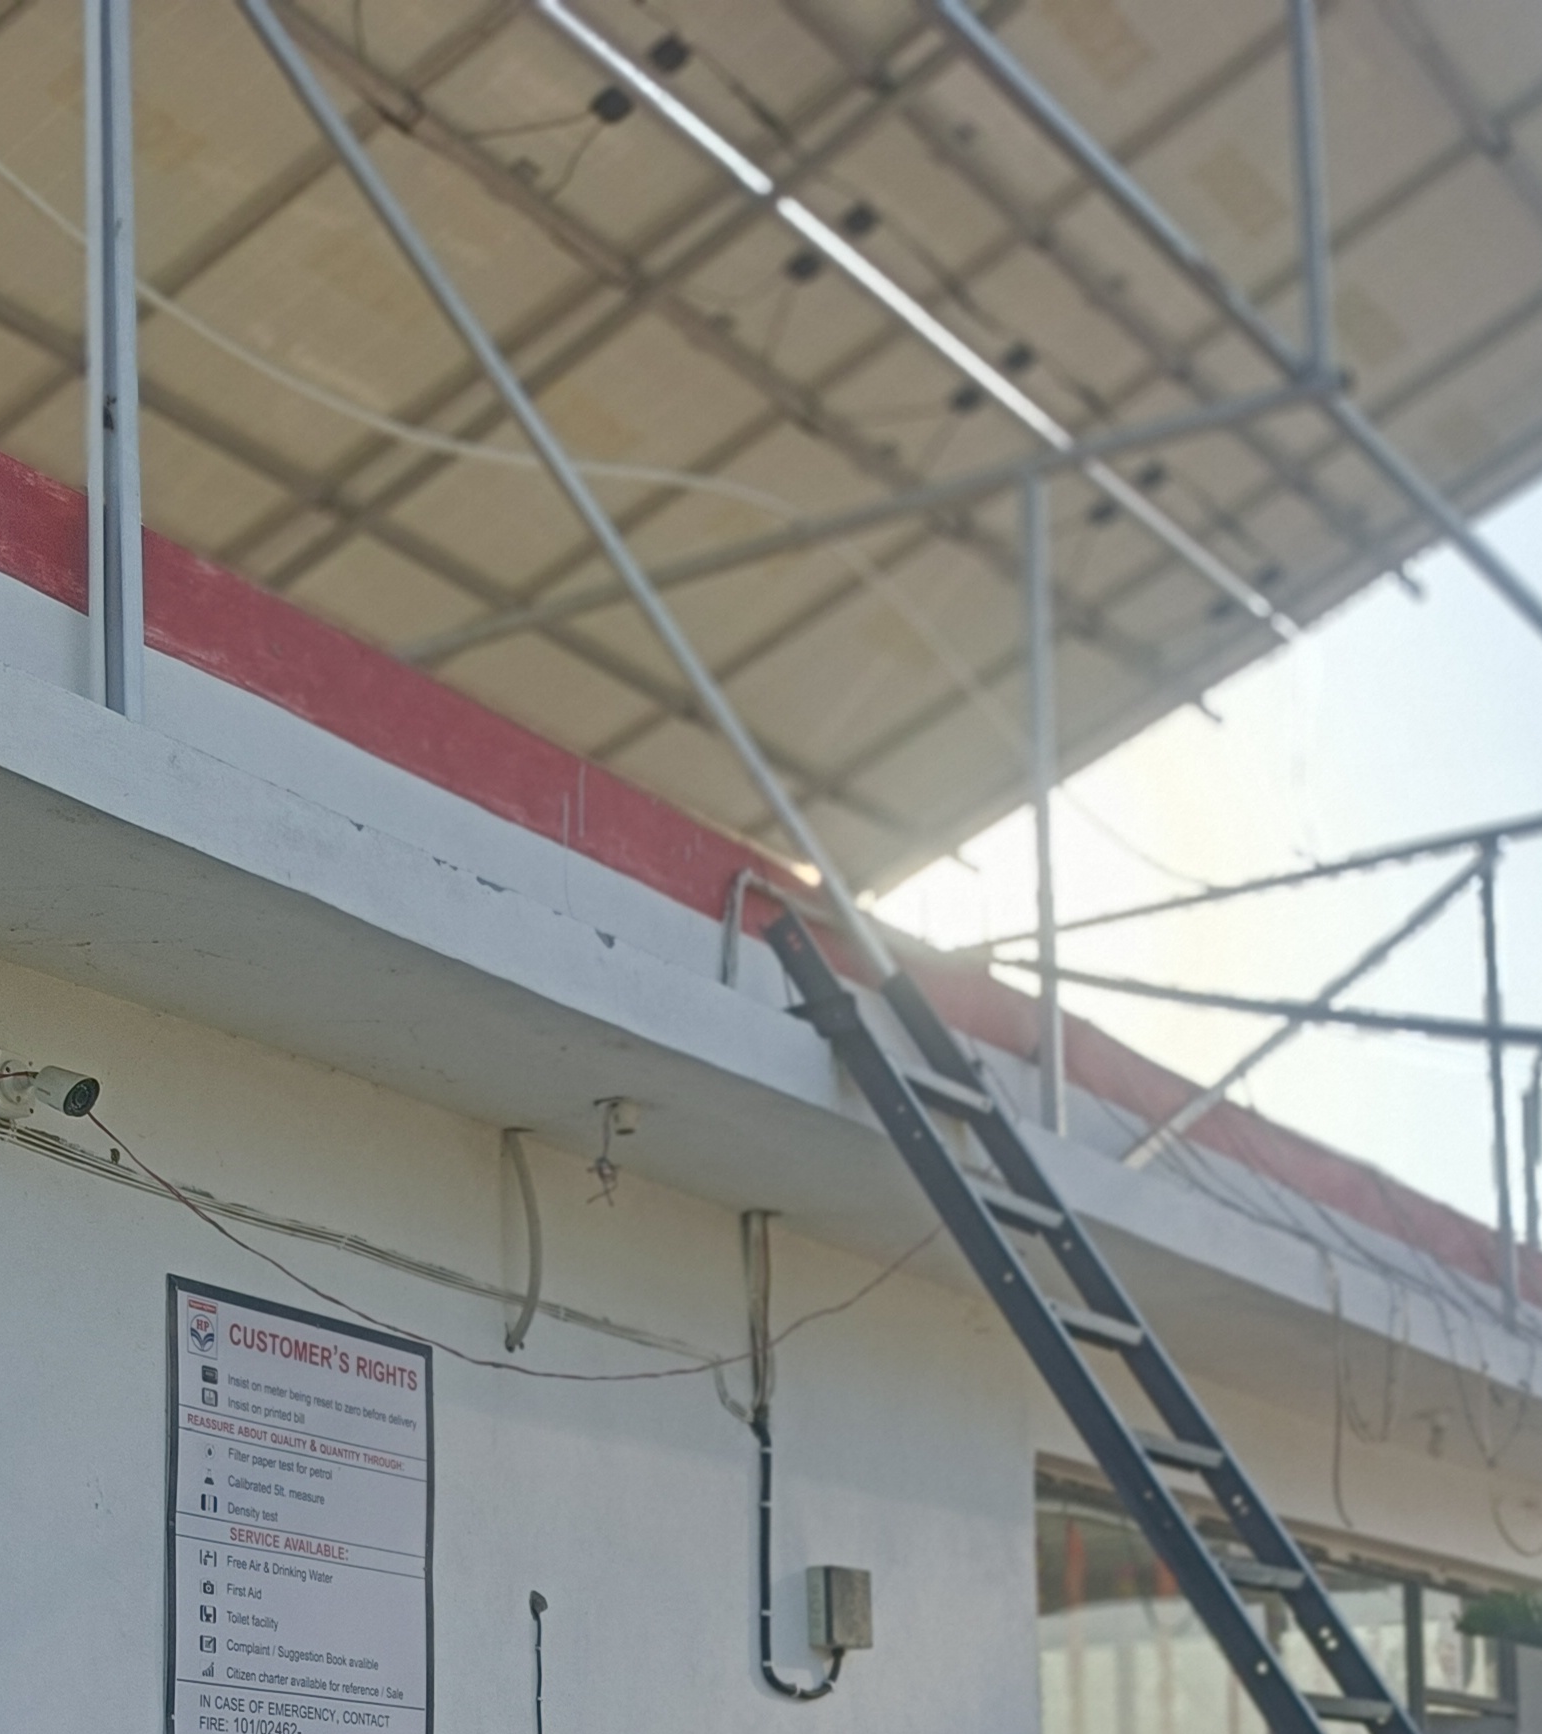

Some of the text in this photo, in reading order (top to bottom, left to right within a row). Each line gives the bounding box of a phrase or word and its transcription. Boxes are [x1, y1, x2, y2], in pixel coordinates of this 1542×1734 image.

[196, 1319, 210, 1332] HP
[356, 1356, 418, 1391] RIGHTS
[228, 1374, 417, 1431] Insist on meter being reset to zero before delivery
[228, 1397, 305, 1425] Insist on printed bill
[187, 1413, 235, 1434] REASSURE
[238, 1426, 268, 1440] ABOUT
[270, 1433, 307, 1449] QUALITY
[309, 1439, 317, 1452] &
[319, 1443, 360, 1461] QUANTITY
[228, 1447, 333, 1480] Filter paper test for petrol
[227, 1475, 272, 1494] Calibrated
[289, 1489, 325, 1505] measure
[227, 1501, 278, 1522] Density test
[229, 1527, 349, 1561] SERVICE AVAILABLE:
[227, 1555, 333, 1584] Free Air & Drinking Water
[226, 1583, 262, 1600] First Aid
[226, 1610, 279, 1632] Toilet facility
[226, 1639, 270, 1656] Complaint
[277, 1645, 324, 1663] Suggestion
[326, 1652, 347, 1666] Book
[226, 1666, 256, 1682] Citizen
[258, 1671, 288, 1685] charter
[290, 1676, 327, 1691] available
[329, 1679, 340, 1692] for
[342, 1682, 379, 1697] reference
[386, 1686, 403, 1700] Sale
[199, 1694, 211, 1708] IN
[215, 1695, 245, 1712] CASE
[249, 1699, 264, 1714] OF
[343, 1710, 390, 1728] CONTACT
[199, 1715, 229, 1732] FIRE:
